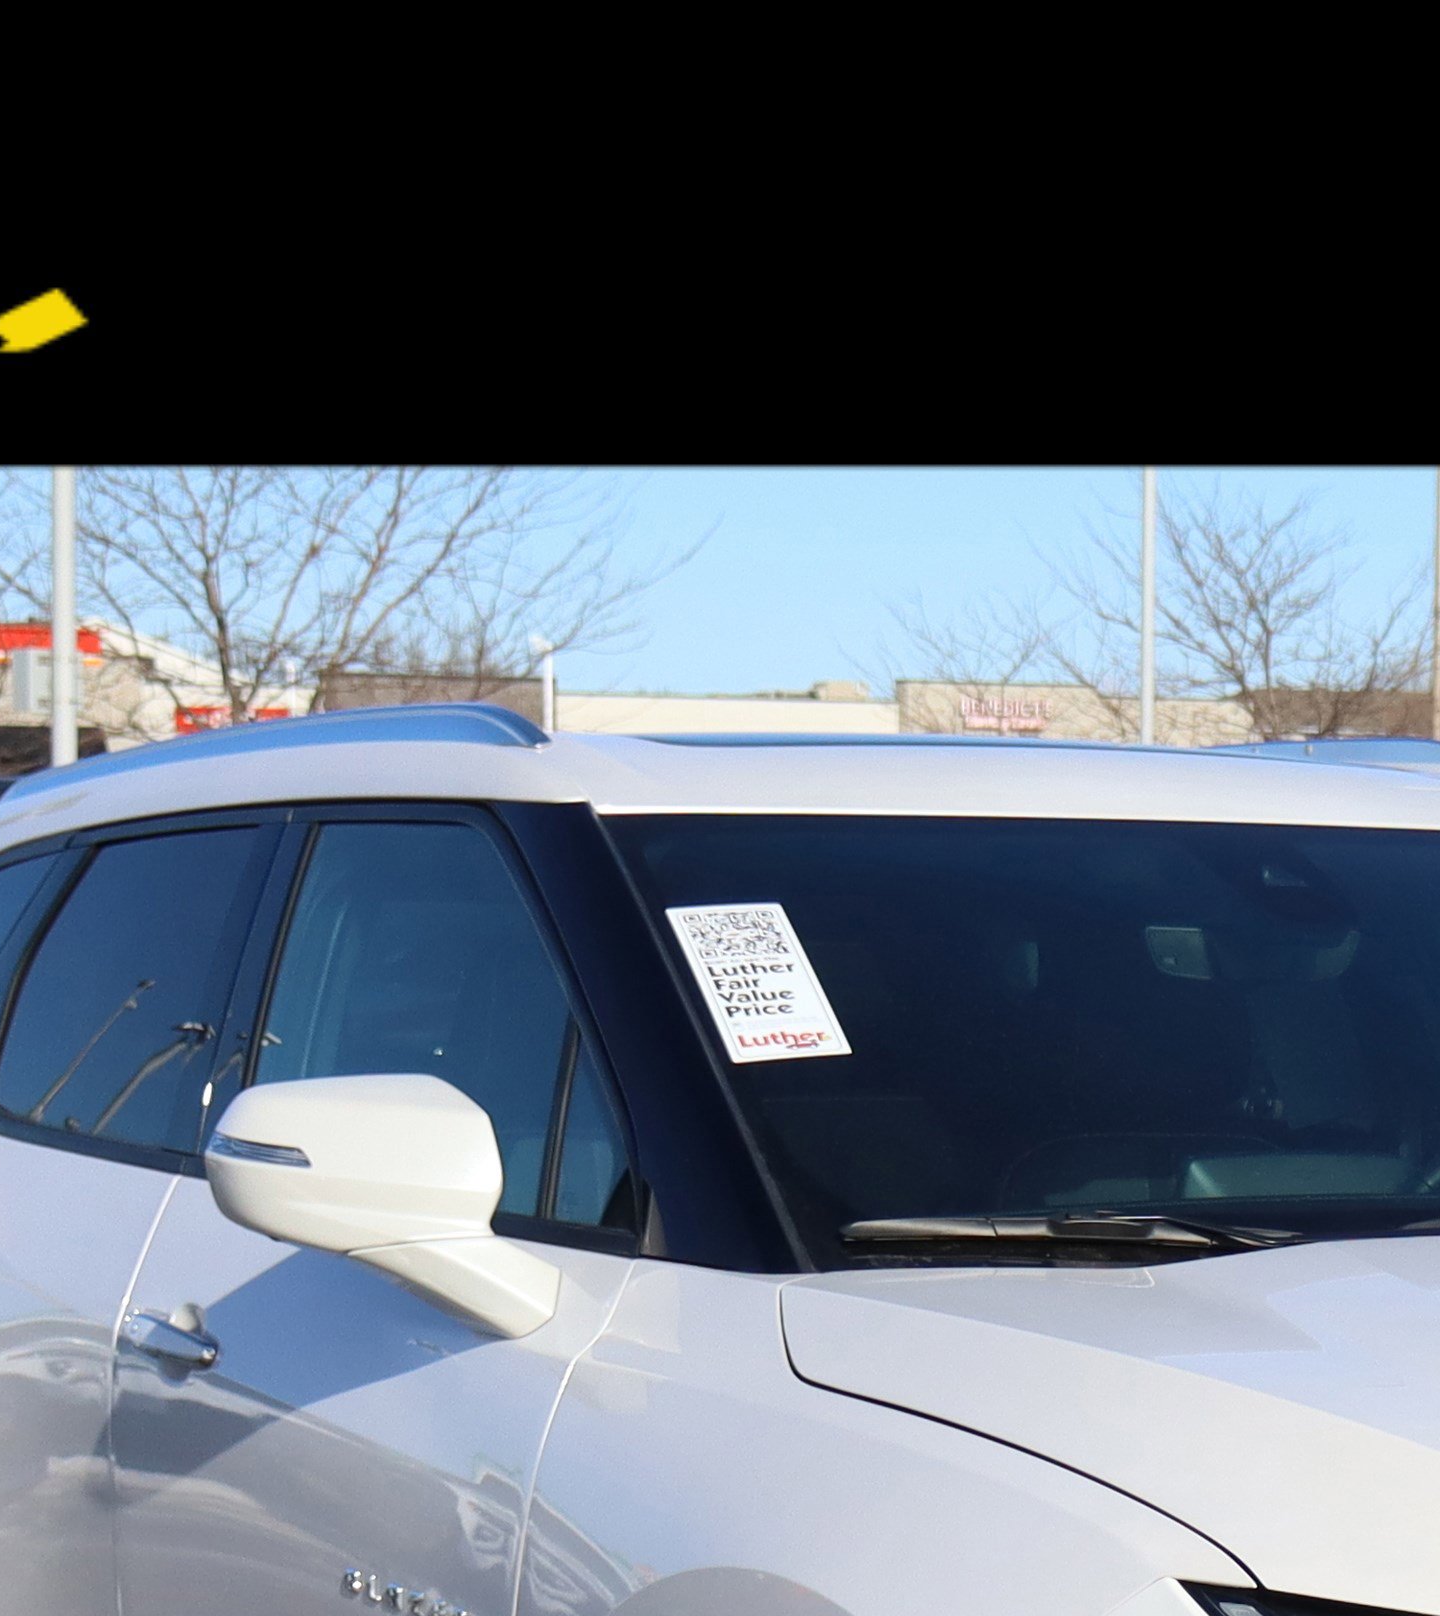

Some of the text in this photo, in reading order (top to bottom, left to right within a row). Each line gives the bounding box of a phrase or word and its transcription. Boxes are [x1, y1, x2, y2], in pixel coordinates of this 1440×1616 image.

[708, 963, 794, 977] Luther
[713, 978, 760, 991] Fair
[718, 990, 795, 1003] Value
[725, 1005, 794, 1018] Price
[738, 1032, 826, 1047] Luther
